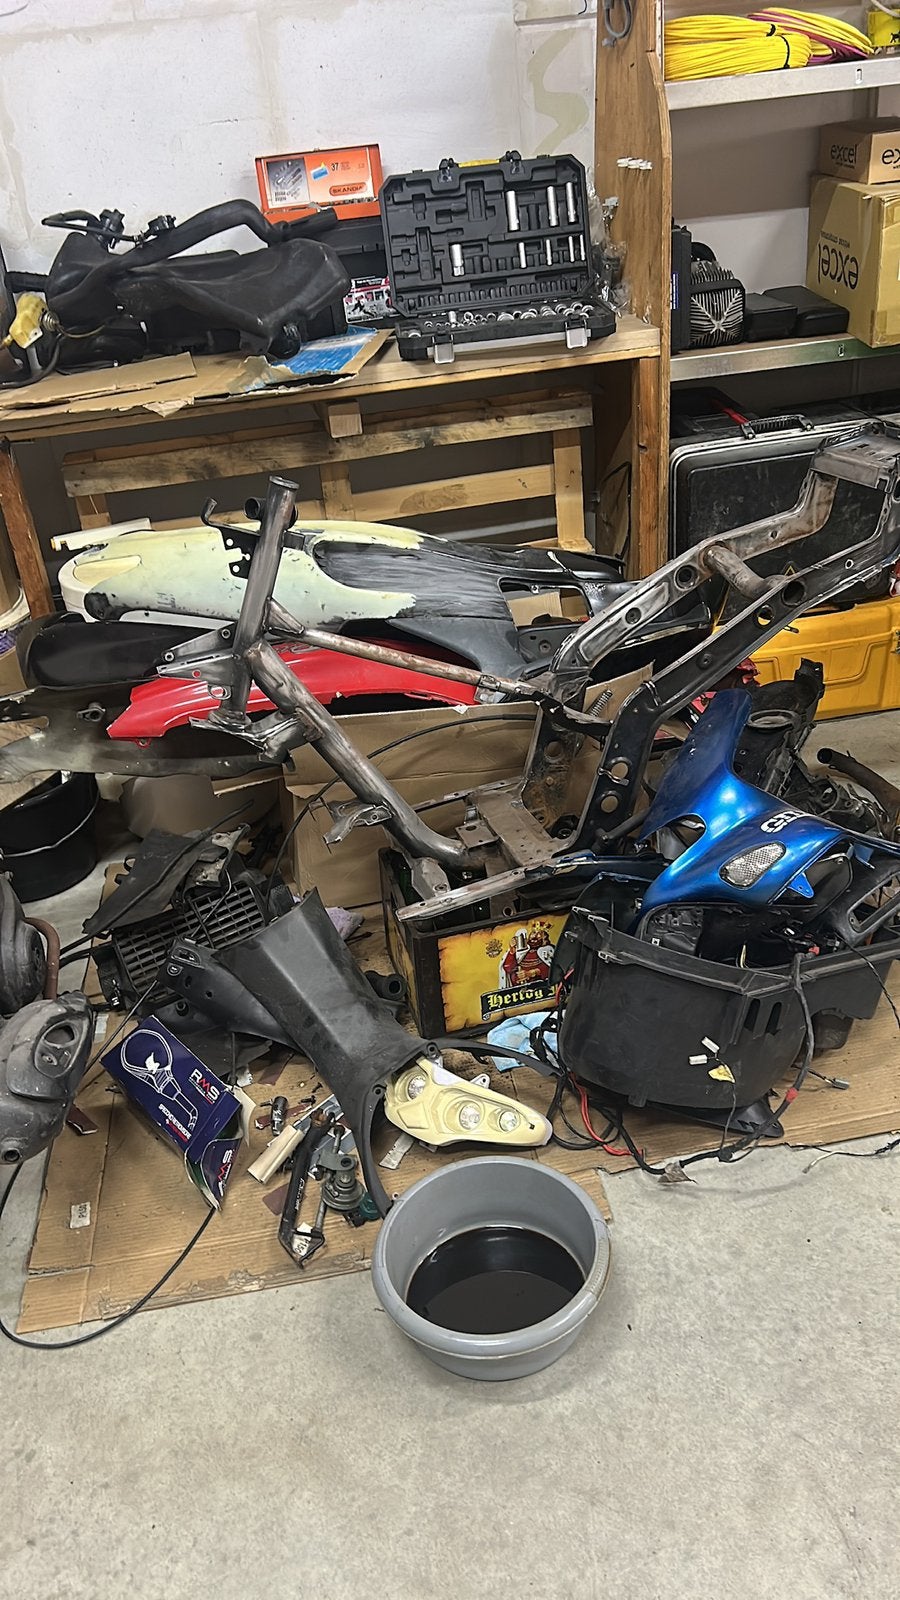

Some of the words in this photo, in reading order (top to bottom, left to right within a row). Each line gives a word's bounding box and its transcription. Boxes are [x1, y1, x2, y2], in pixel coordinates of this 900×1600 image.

[830, 143, 858, 164] excel
[330, 162, 339, 172] 37
[817, 243, 859, 290] excel
[487, 988, 544, 1010] Hertog
[189, 1068, 220, 1101] RMS
